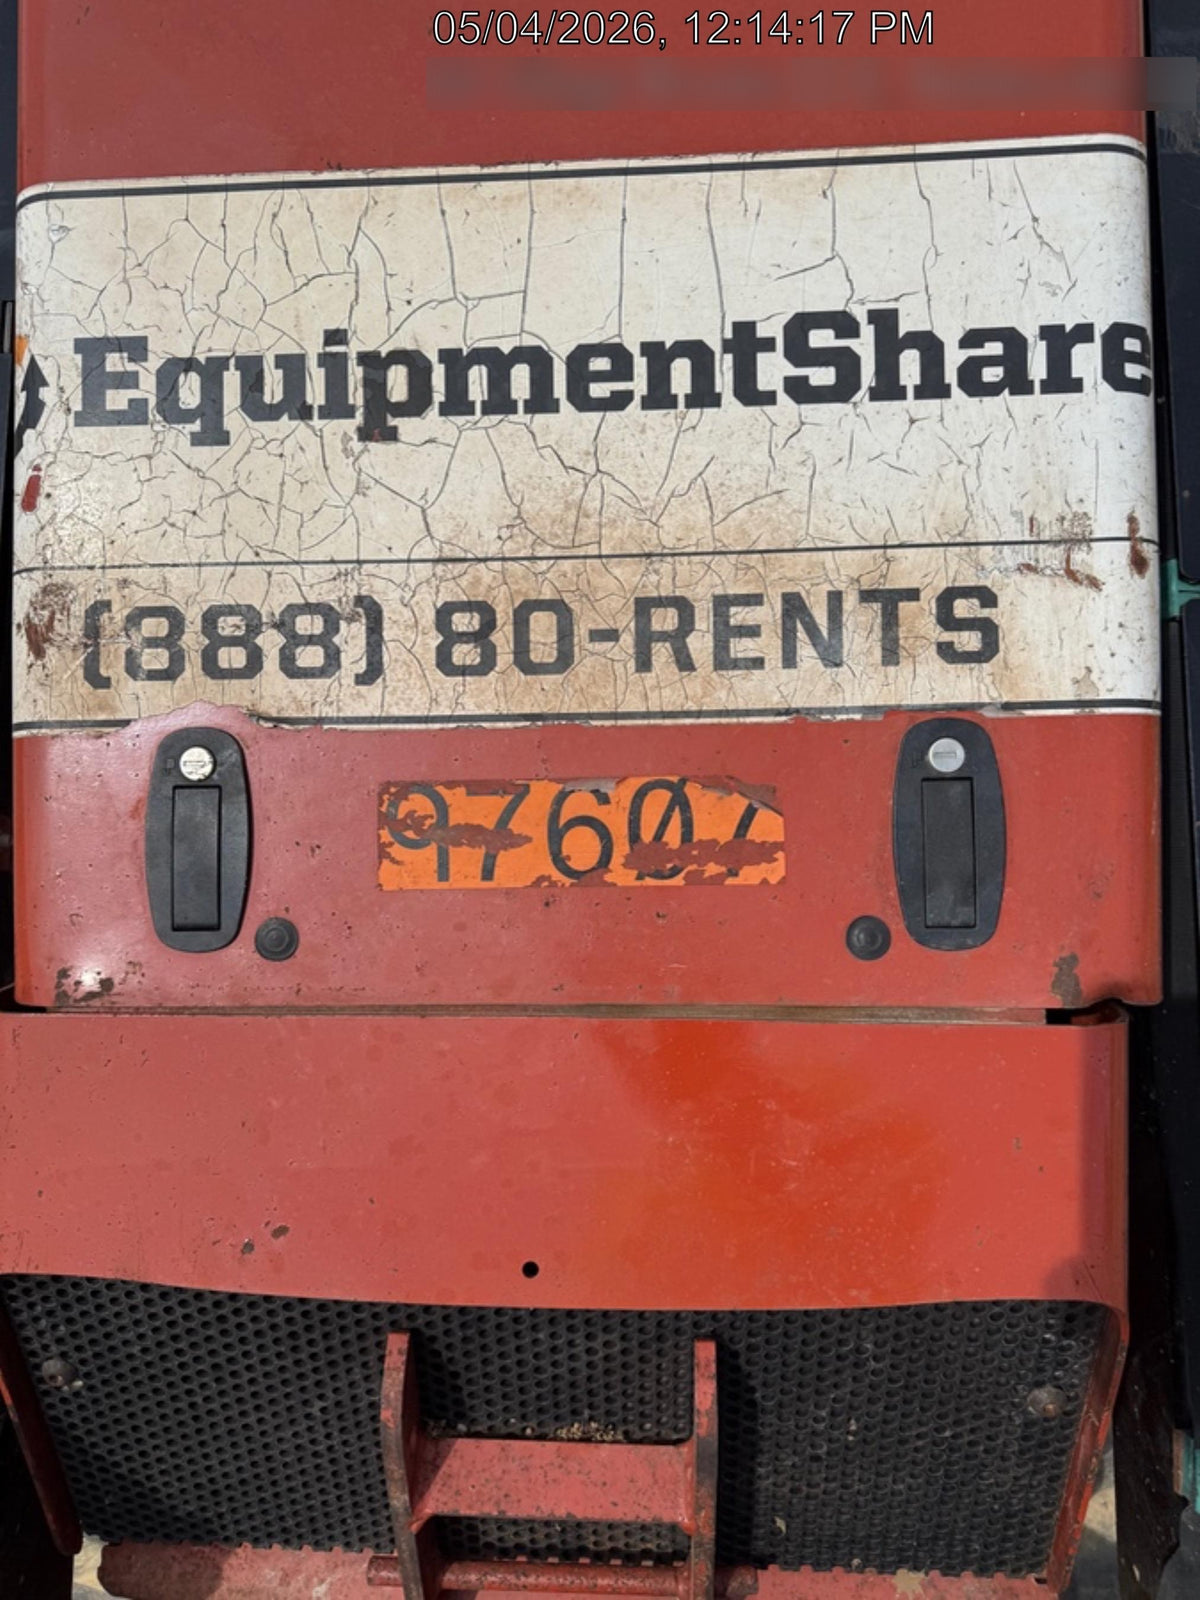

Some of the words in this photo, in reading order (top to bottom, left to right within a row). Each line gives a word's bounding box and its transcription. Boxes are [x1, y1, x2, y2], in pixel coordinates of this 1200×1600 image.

[73, 308, 1153, 446] EquipmentShare
[82, 593, 385, 689] (888)
[434, 583, 1001, 678] 80-RENTS
